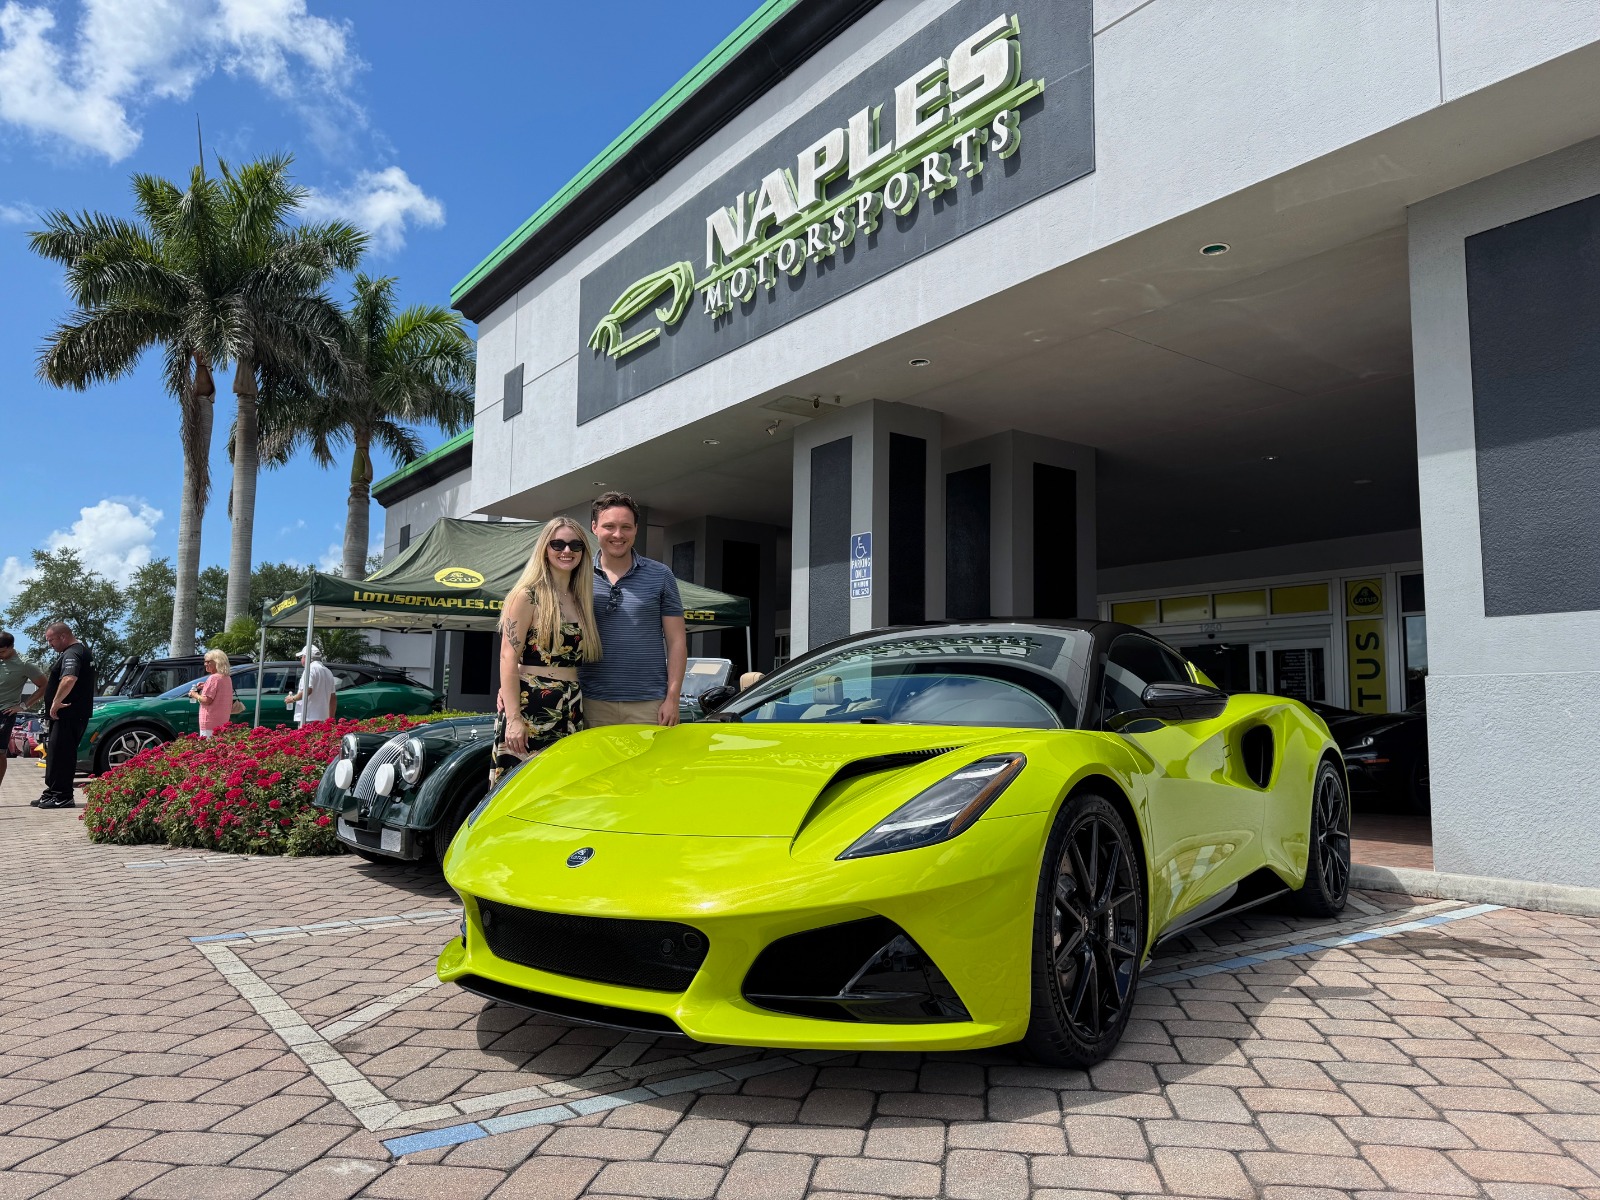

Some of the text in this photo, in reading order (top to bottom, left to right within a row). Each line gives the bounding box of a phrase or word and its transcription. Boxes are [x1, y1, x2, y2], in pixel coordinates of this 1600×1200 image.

[706, 13, 1020, 271] NAPLES
[704, 110, 1020, 317] MOTORSPORTS
[353, 590, 504, 610] LOTUSOFNAPLES.CO
[684, 610, 716, 621] 655
[1355, 631, 1382, 708] TUS
